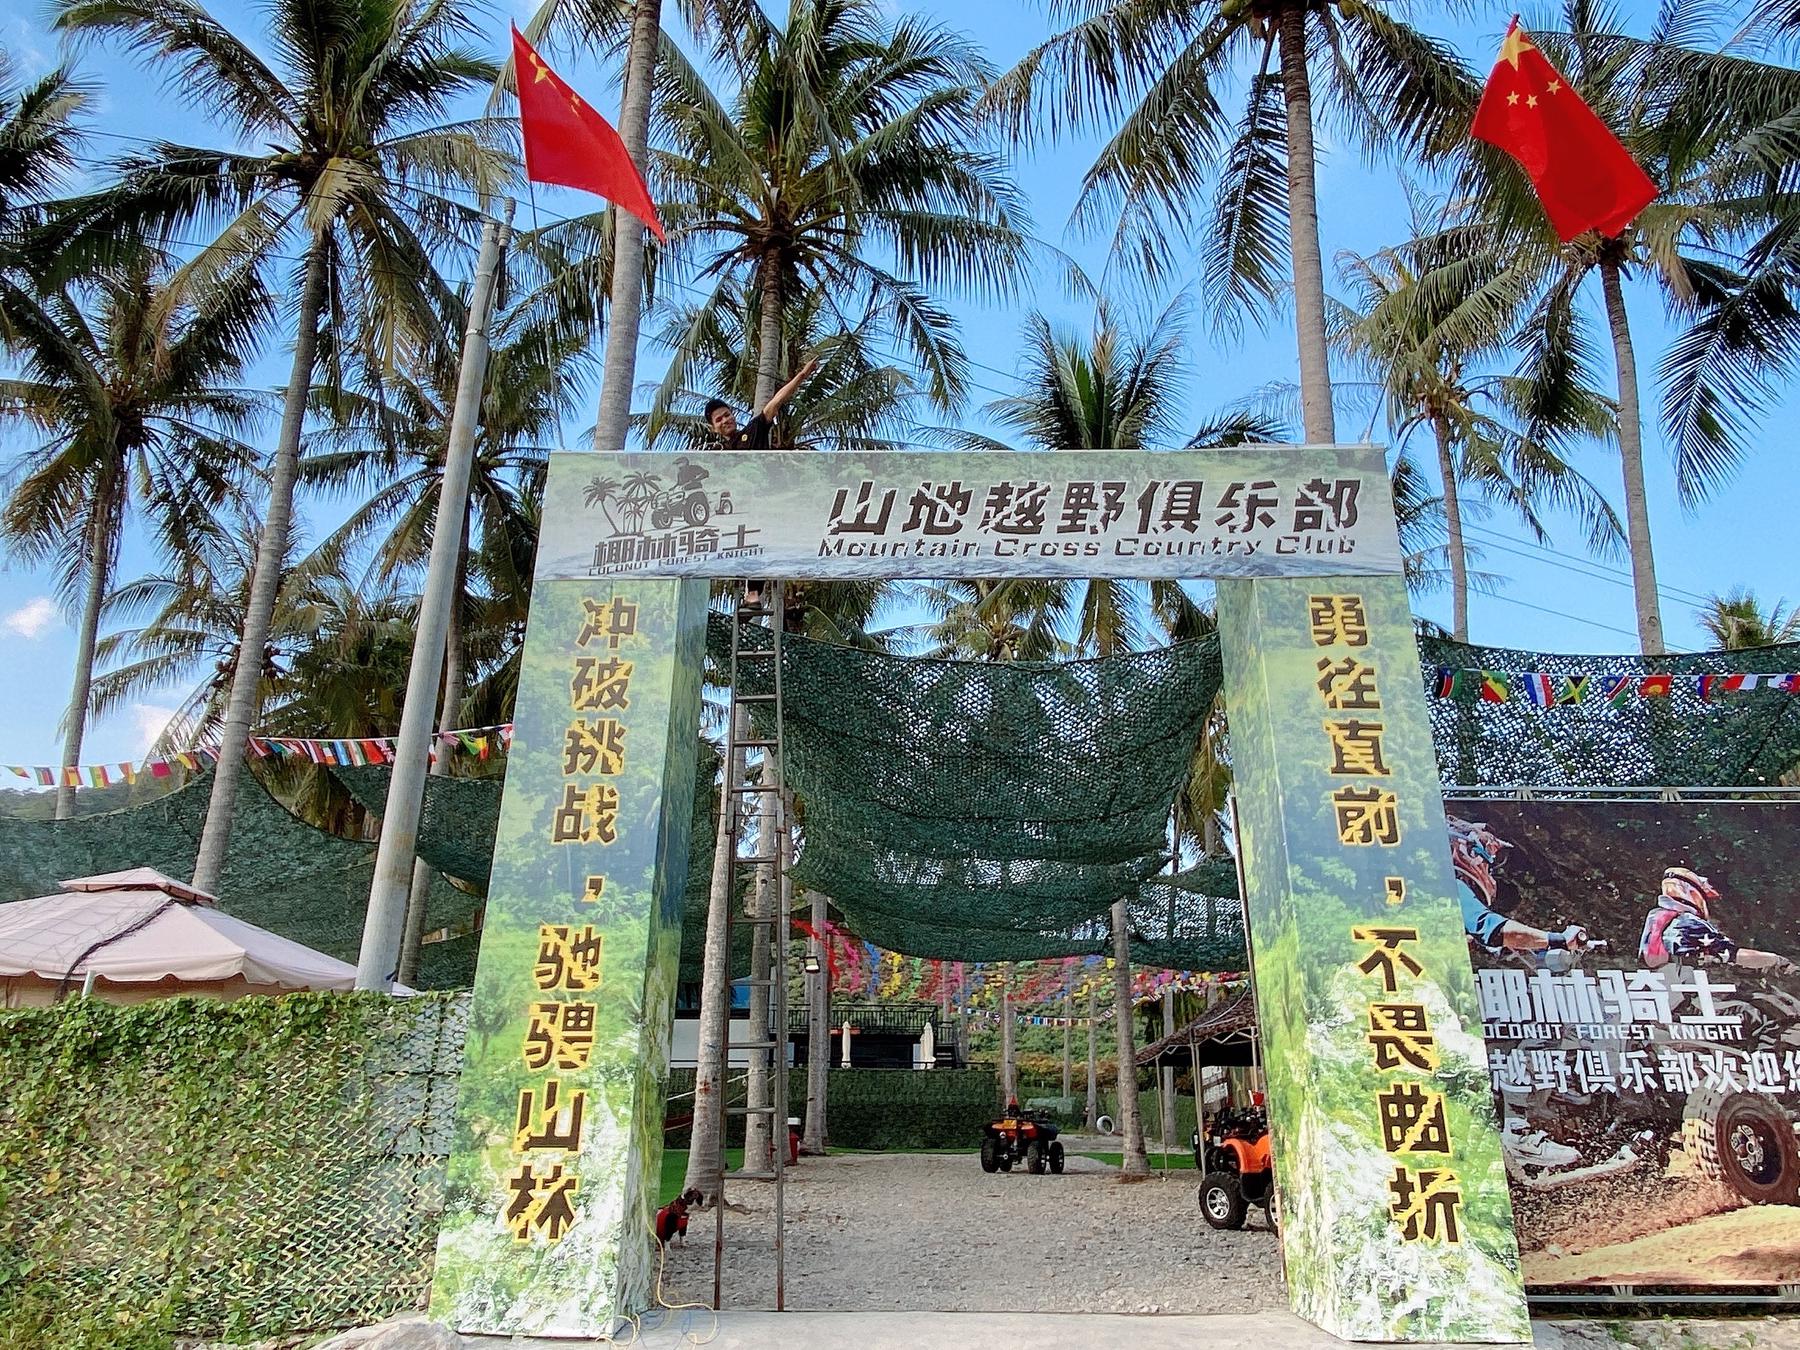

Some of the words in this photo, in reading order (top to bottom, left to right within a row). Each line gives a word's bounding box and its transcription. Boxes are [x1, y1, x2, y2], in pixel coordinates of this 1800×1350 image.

[827, 478, 1361, 536] 山地越野俱乐部
[593, 524, 761, 567] 椰林骑士
[818, 537, 980, 558] Mountain
[994, 537, 1101, 557] Cross
[1114, 536, 1262, 556] Country
[1275, 534, 1357, 555] Club
[588, 561, 649, 576] COCONUT
[658, 553, 709, 567] FOREST
[717, 546, 766, 560] KNIGHT
[1484, 1023, 1562, 1039] OCONUT
[1575, 1024, 1655, 1040] FOREST
[1668, 1024, 1743, 1040] KNIGHT
